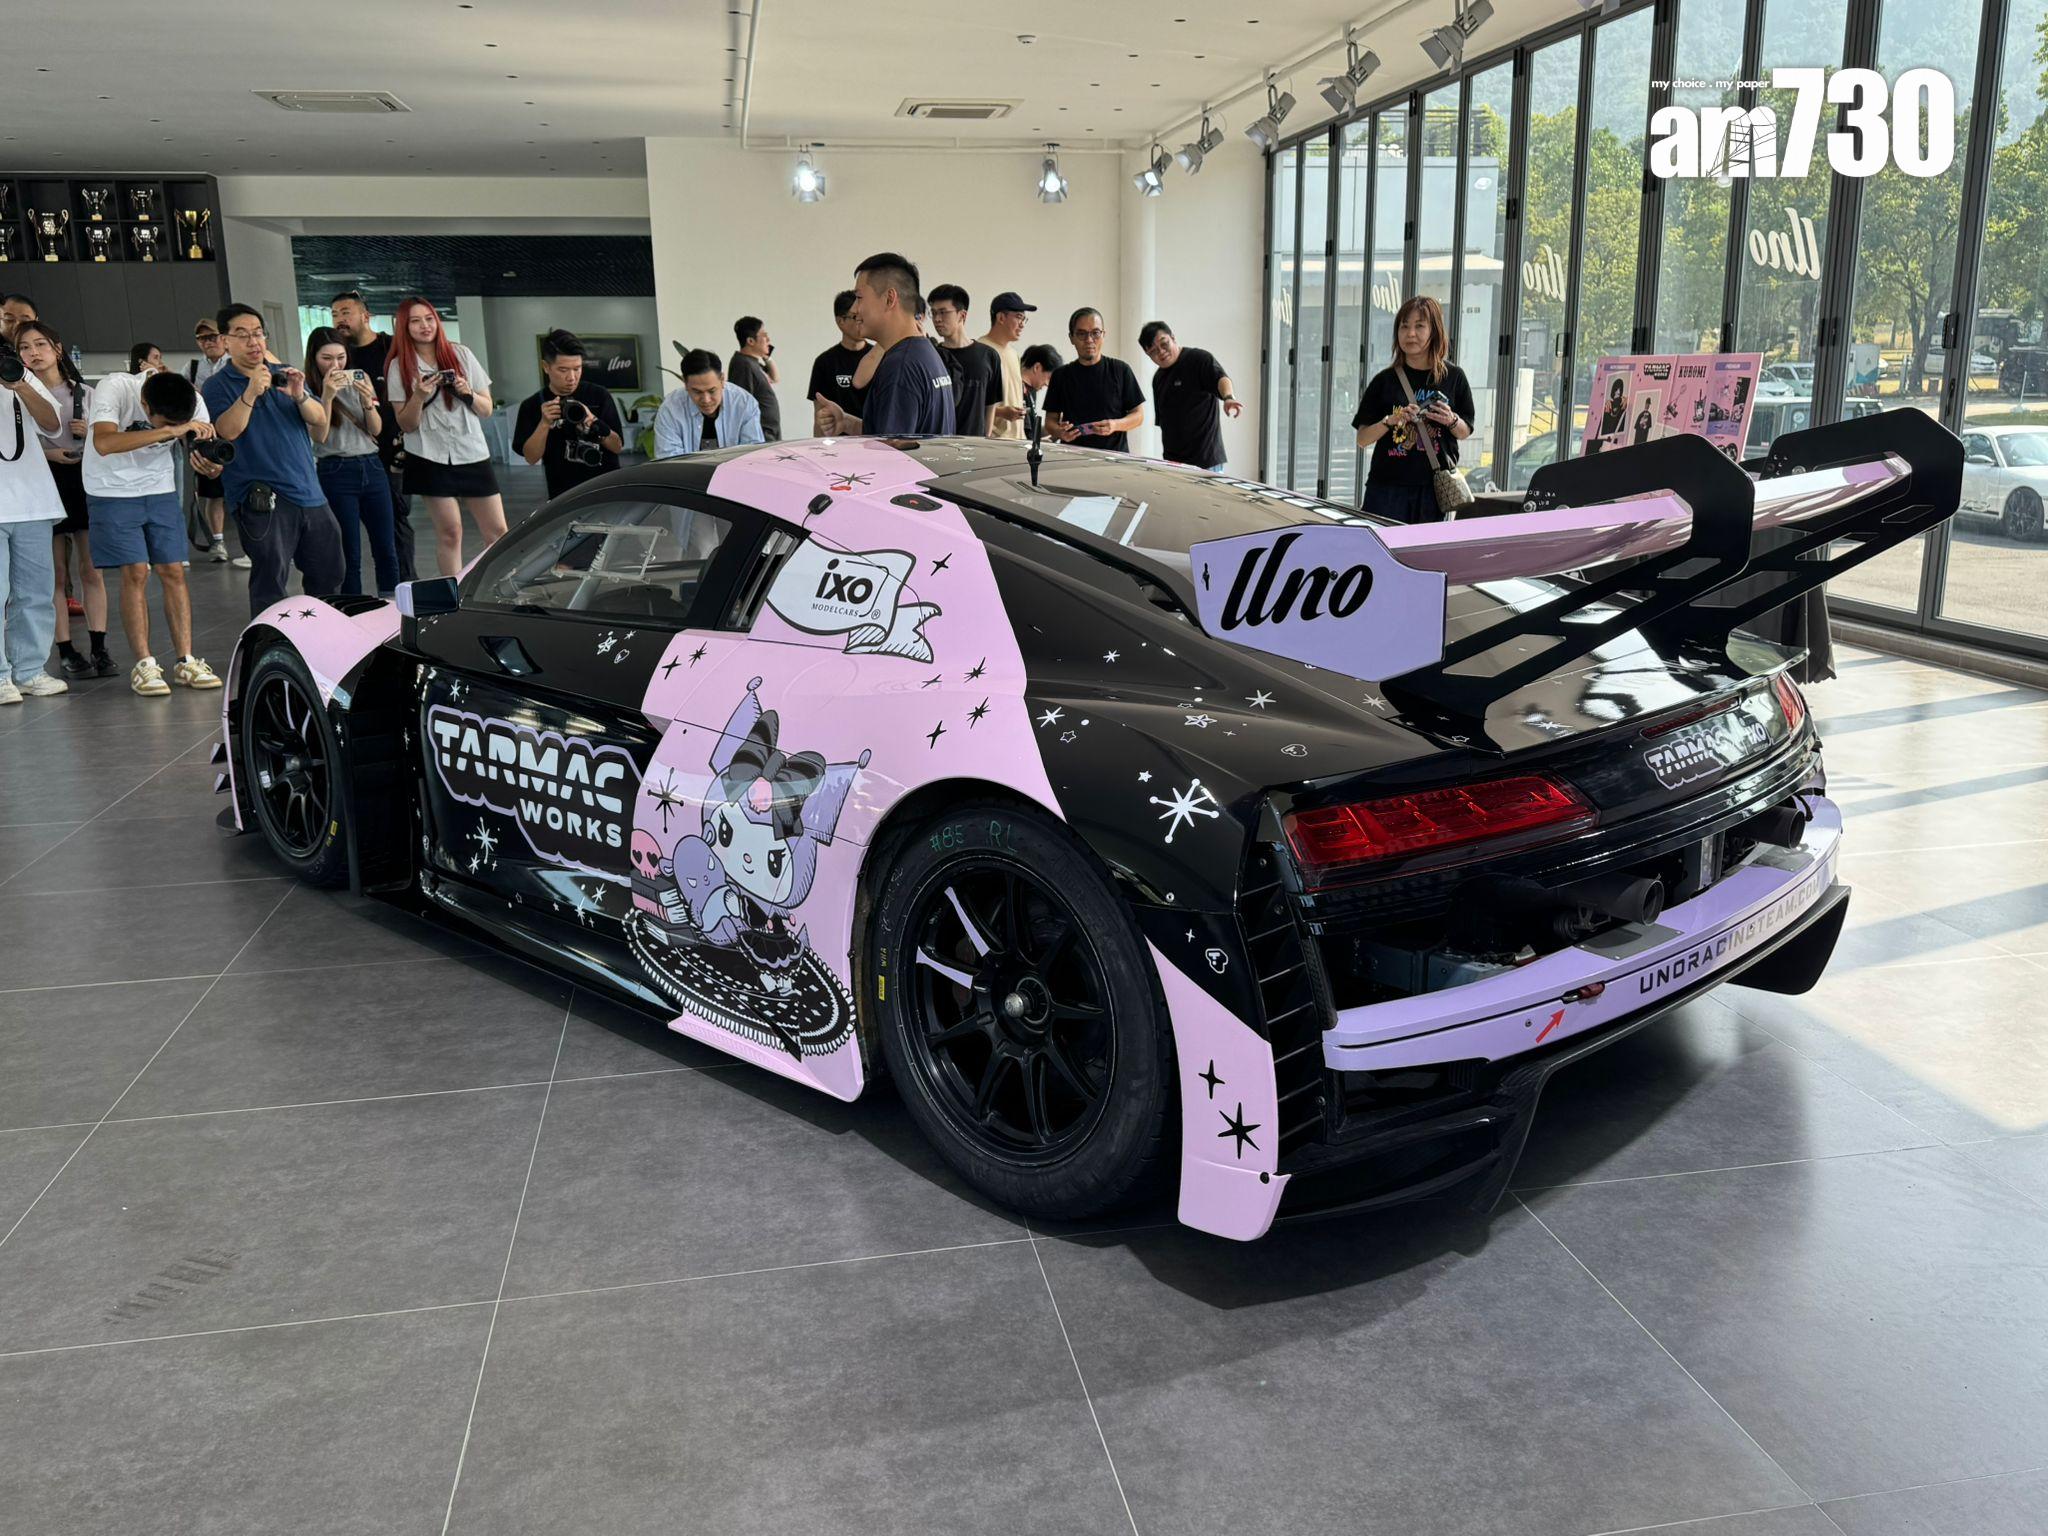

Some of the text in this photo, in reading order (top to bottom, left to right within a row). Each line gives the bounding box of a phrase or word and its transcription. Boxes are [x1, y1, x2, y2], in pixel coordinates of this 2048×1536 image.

[812, 603, 859, 617] MODELCARS
[434, 719, 625, 814] TARMAC
[519, 797, 624, 849] WORKS
[1639, 875, 1820, 994] UNORACINGTEAM.COM
